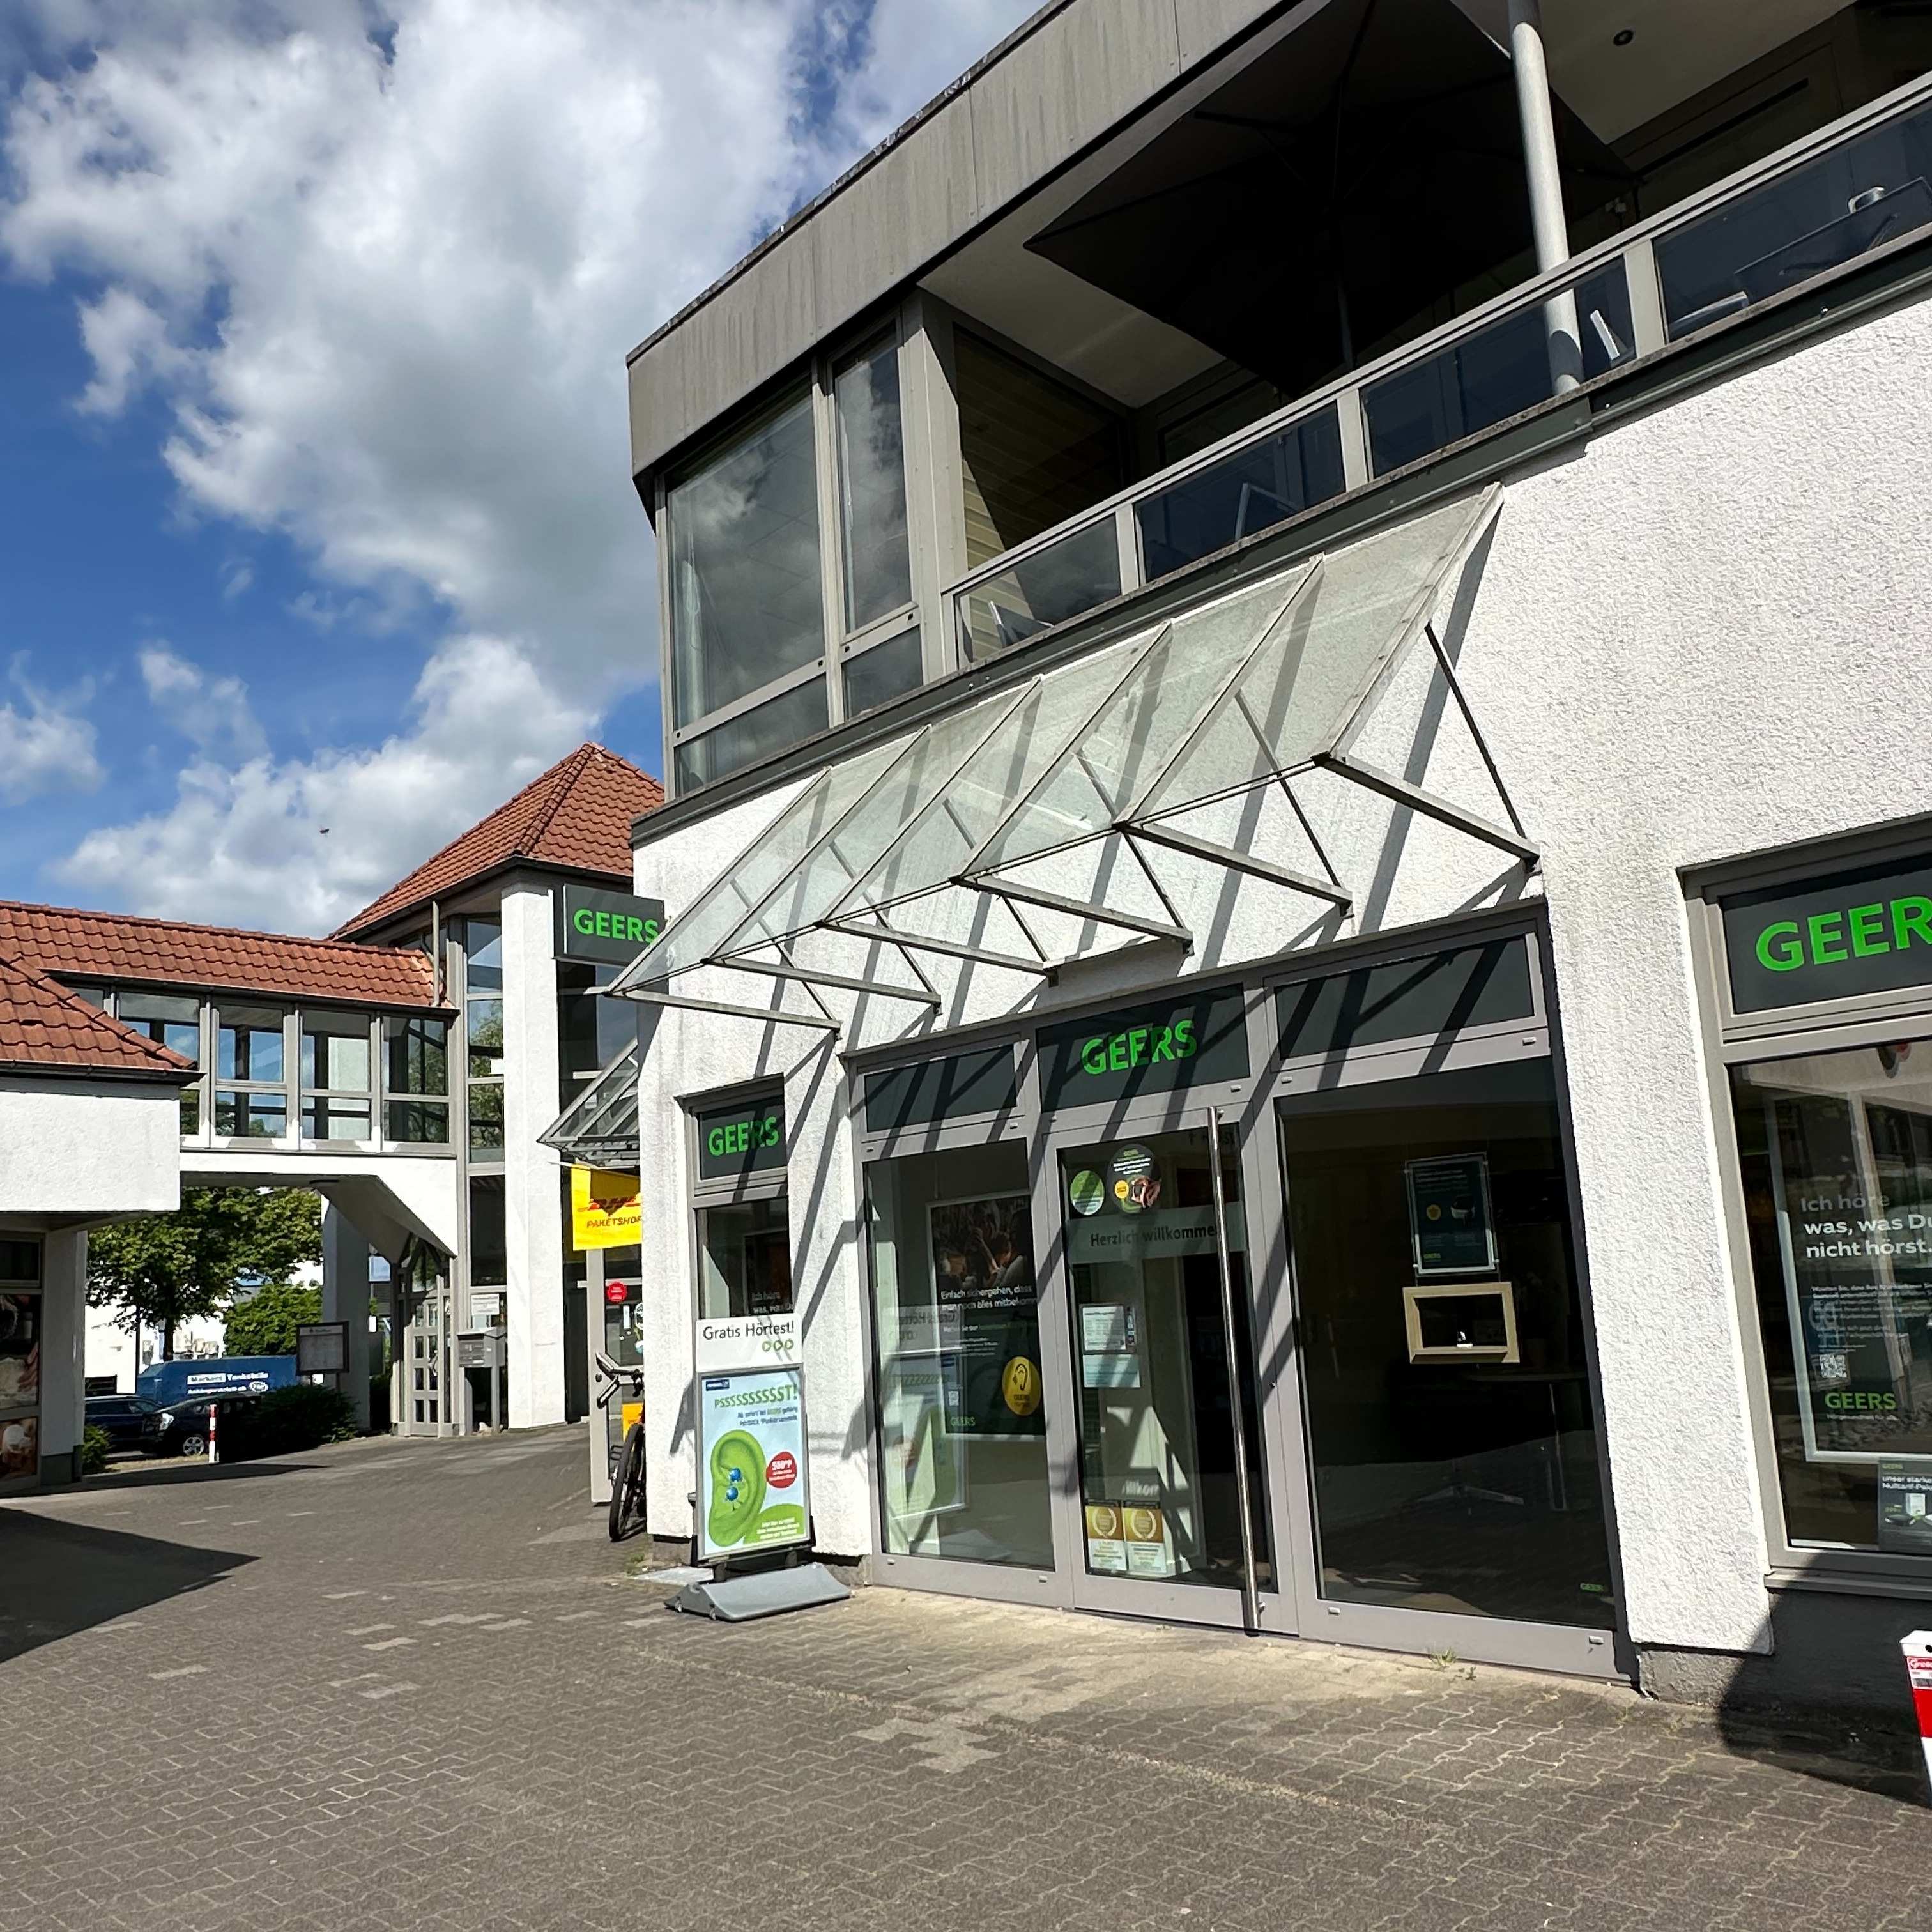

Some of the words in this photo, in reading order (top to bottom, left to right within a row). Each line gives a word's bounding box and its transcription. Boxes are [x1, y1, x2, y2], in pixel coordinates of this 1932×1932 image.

[574, 908, 659, 944] GEERS
[1082, 1019, 1197, 1075] GEERS
[708, 1116, 779, 1157] GEERS
[1800, 1195, 1833, 1212] Ich
[1837, 1194, 1890, 1210] höre
[1090, 1227, 1138, 1247] Herzlich
[1142, 1223, 1218, 1243] willkomme
[1804, 1221, 1853, 1236] was,
[1857, 1218, 1903, 1232] was
[1806, 1241, 1862, 1259] nicht
[940, 1289, 966, 1300] Einfach
[703, 1325, 741, 1340] Gratis
[746, 1320, 795, 1337] Hörtest!
[1825, 1392, 1897, 1411] GEERS
[949, 1416, 976, 1427] GEERS
